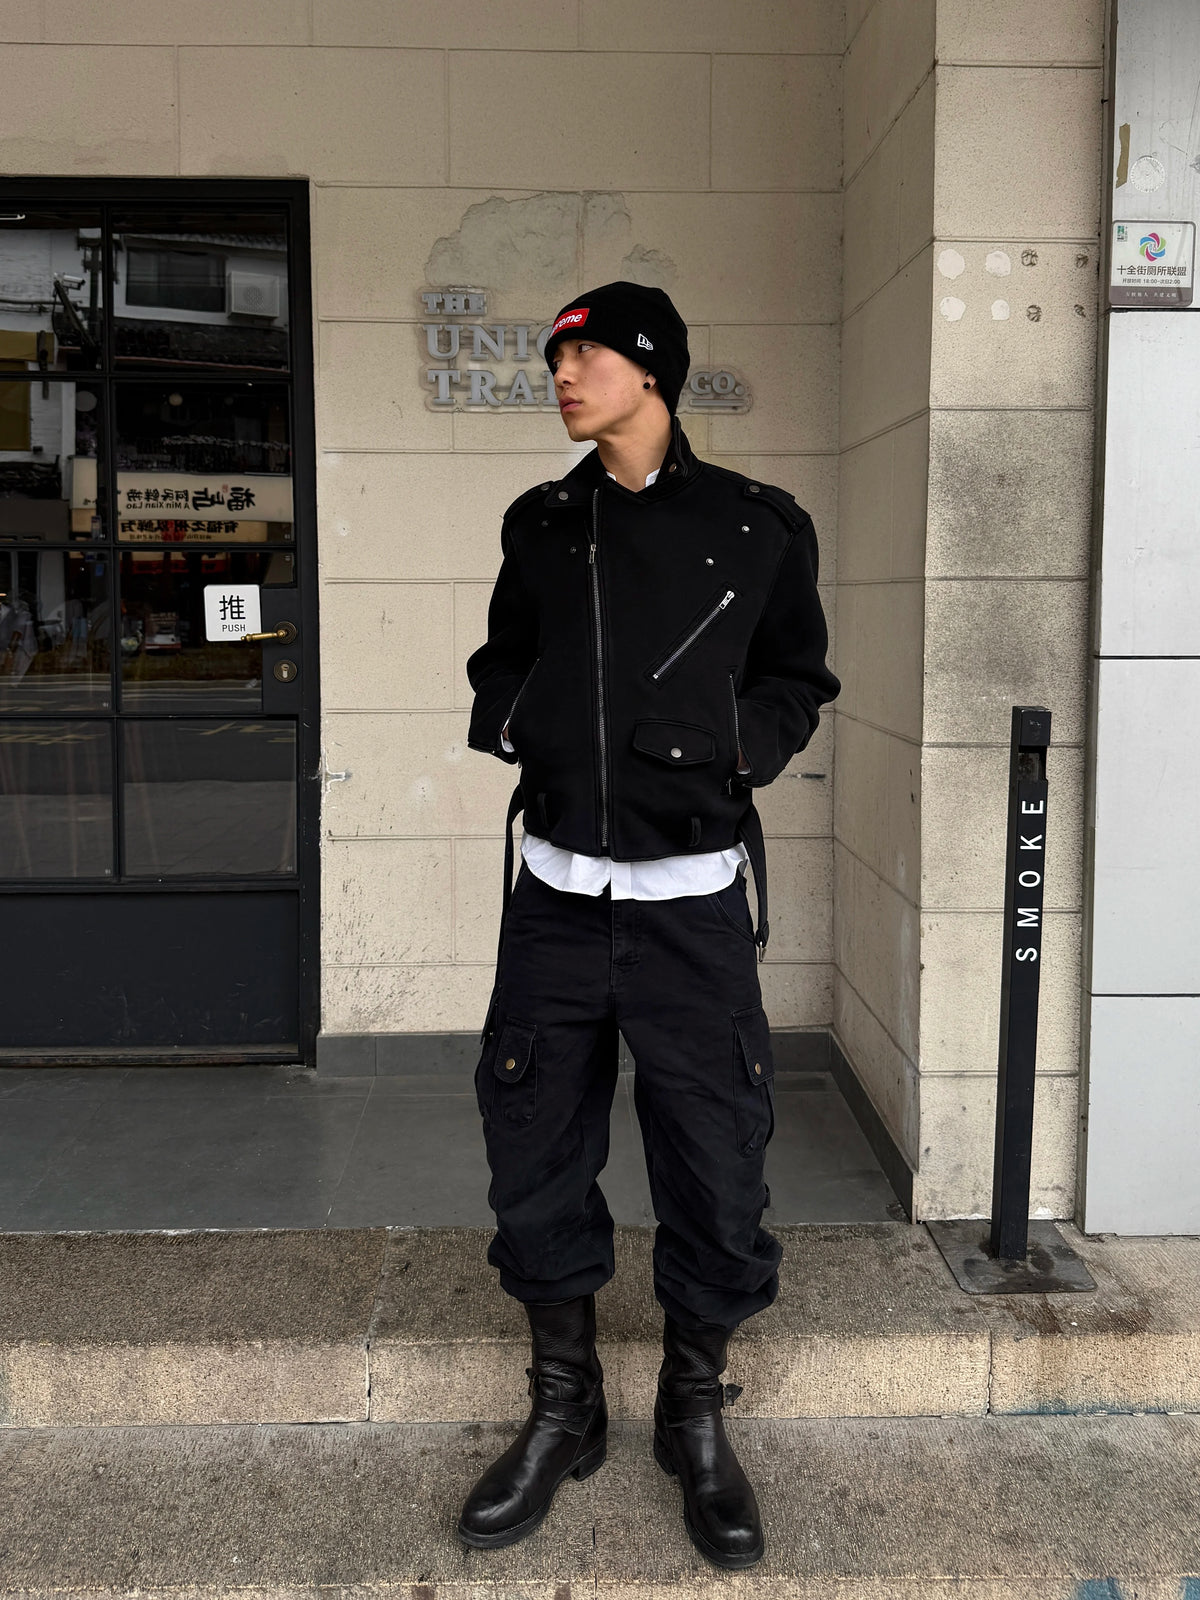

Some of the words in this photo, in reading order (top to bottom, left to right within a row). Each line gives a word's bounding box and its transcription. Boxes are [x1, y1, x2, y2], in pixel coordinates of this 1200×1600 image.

[1116, 265, 1187, 277] 十全街厕所联盟
[422, 293, 487, 314] THE
[690, 371, 745, 396] CO.
[219, 595, 246, 620] 推
[222, 624, 246, 632] PUSH
[1015, 799, 1045, 962] SMOKE
